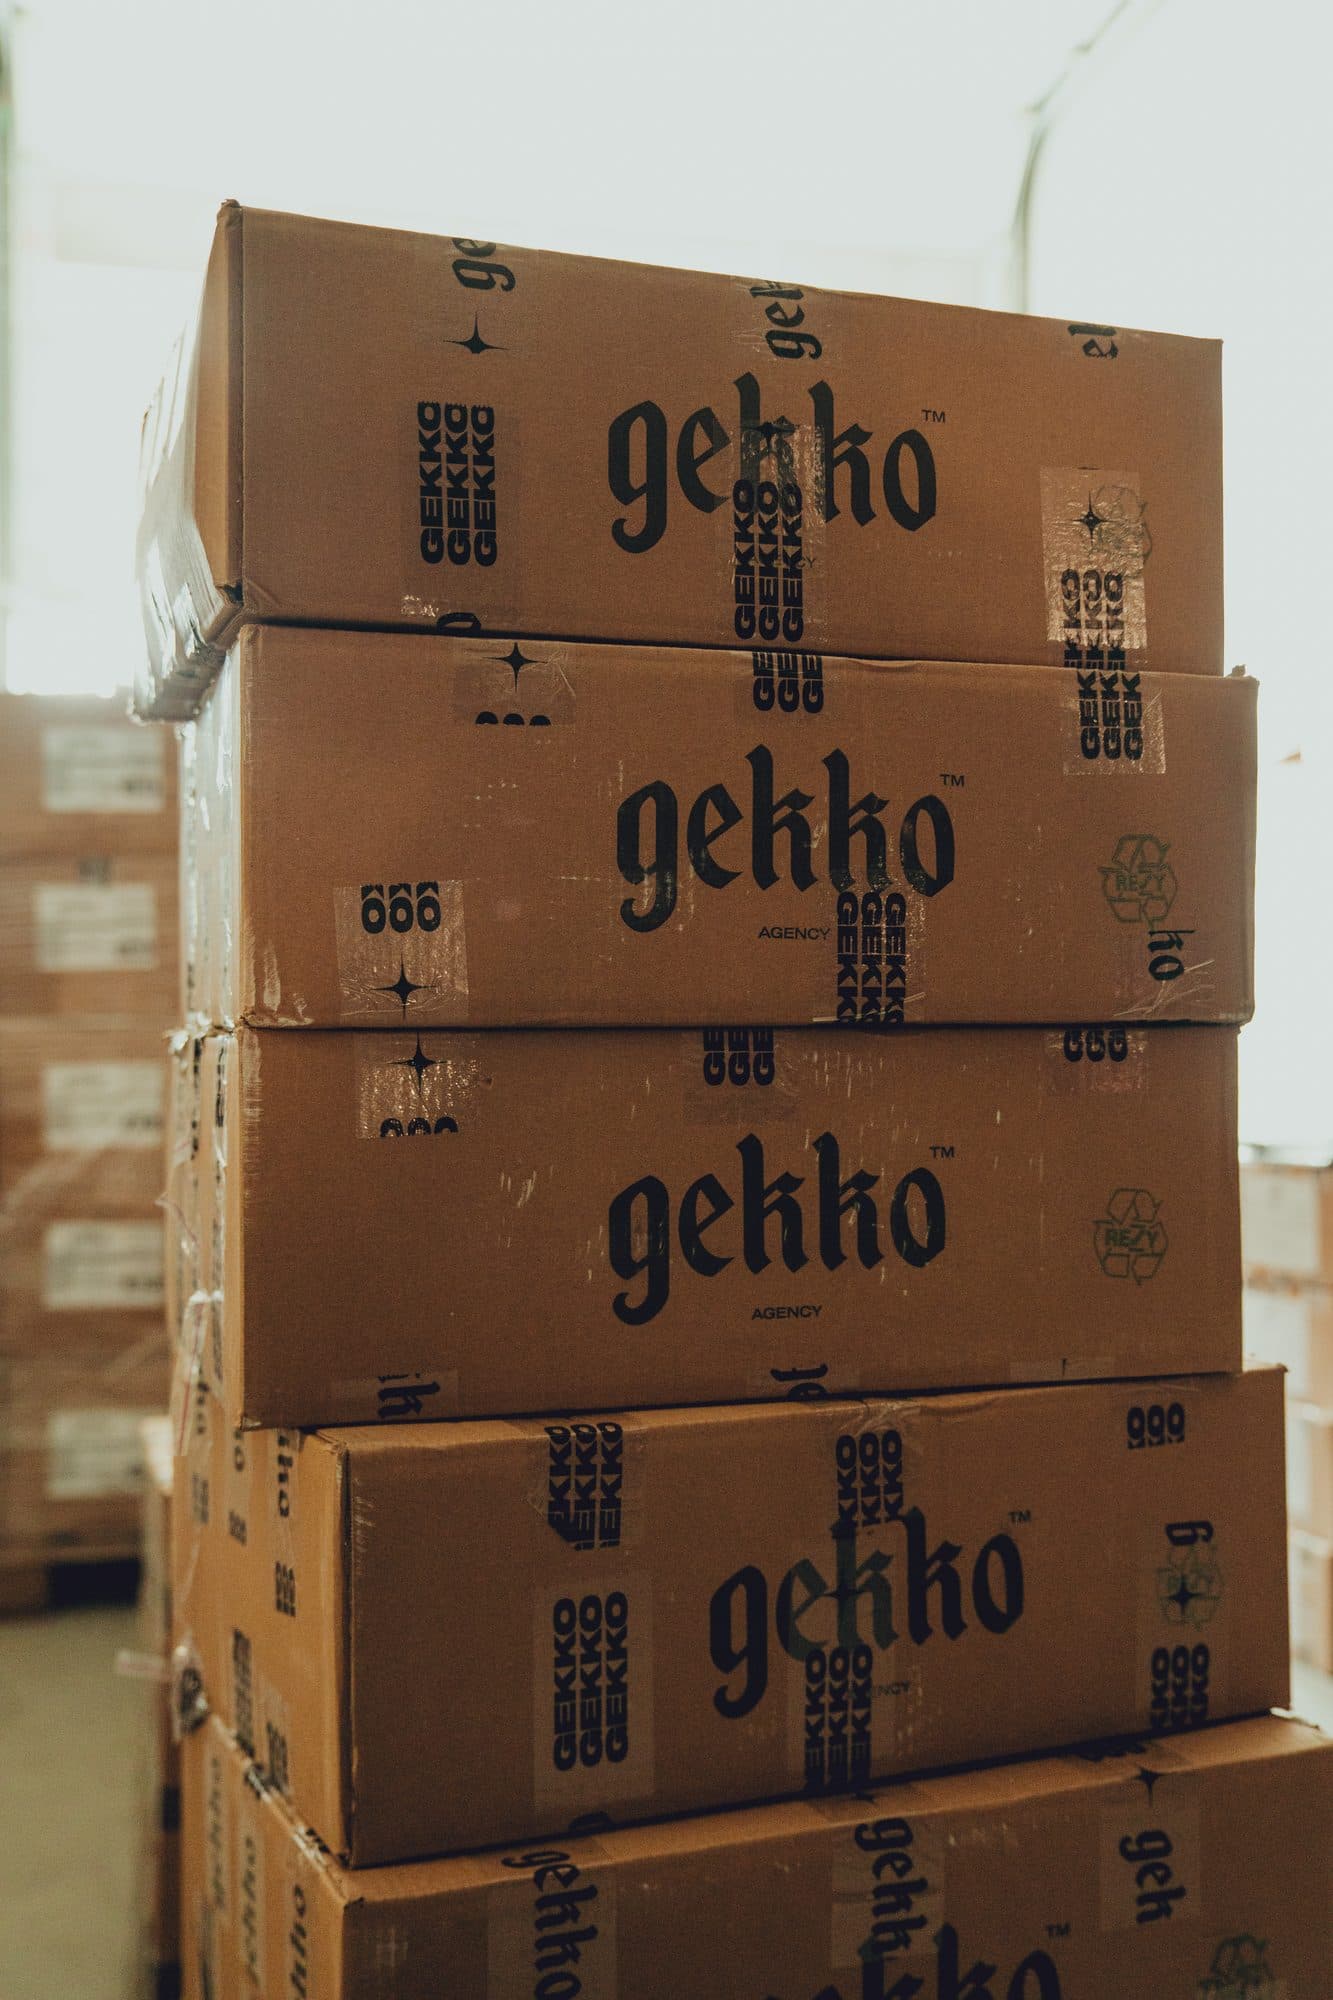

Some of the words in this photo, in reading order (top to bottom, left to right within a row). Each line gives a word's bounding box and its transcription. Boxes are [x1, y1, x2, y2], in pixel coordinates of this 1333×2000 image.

[417, 401, 444, 565] GEKKO
[445, 401, 470, 566] GEKKO
[470, 404, 497, 567] GEKKO
[608, 372, 937, 554] gekko
[732, 478, 756, 640] GEKKO
[757, 480, 780, 641] GEKKO
[780, 480, 804, 643] GEKKO
[617, 743, 955, 933] gekko
[758, 926, 831, 941] AGENCY
[609, 1131, 946, 1326] gekko
[751, 1305, 823, 1321] AGENCY
[553, 1598, 577, 1771] GEKKO
[578, 1595, 602, 1768] GEKKO
[604, 1591, 628, 1763] GEKKO
[709, 1506, 1024, 1719] gekko
